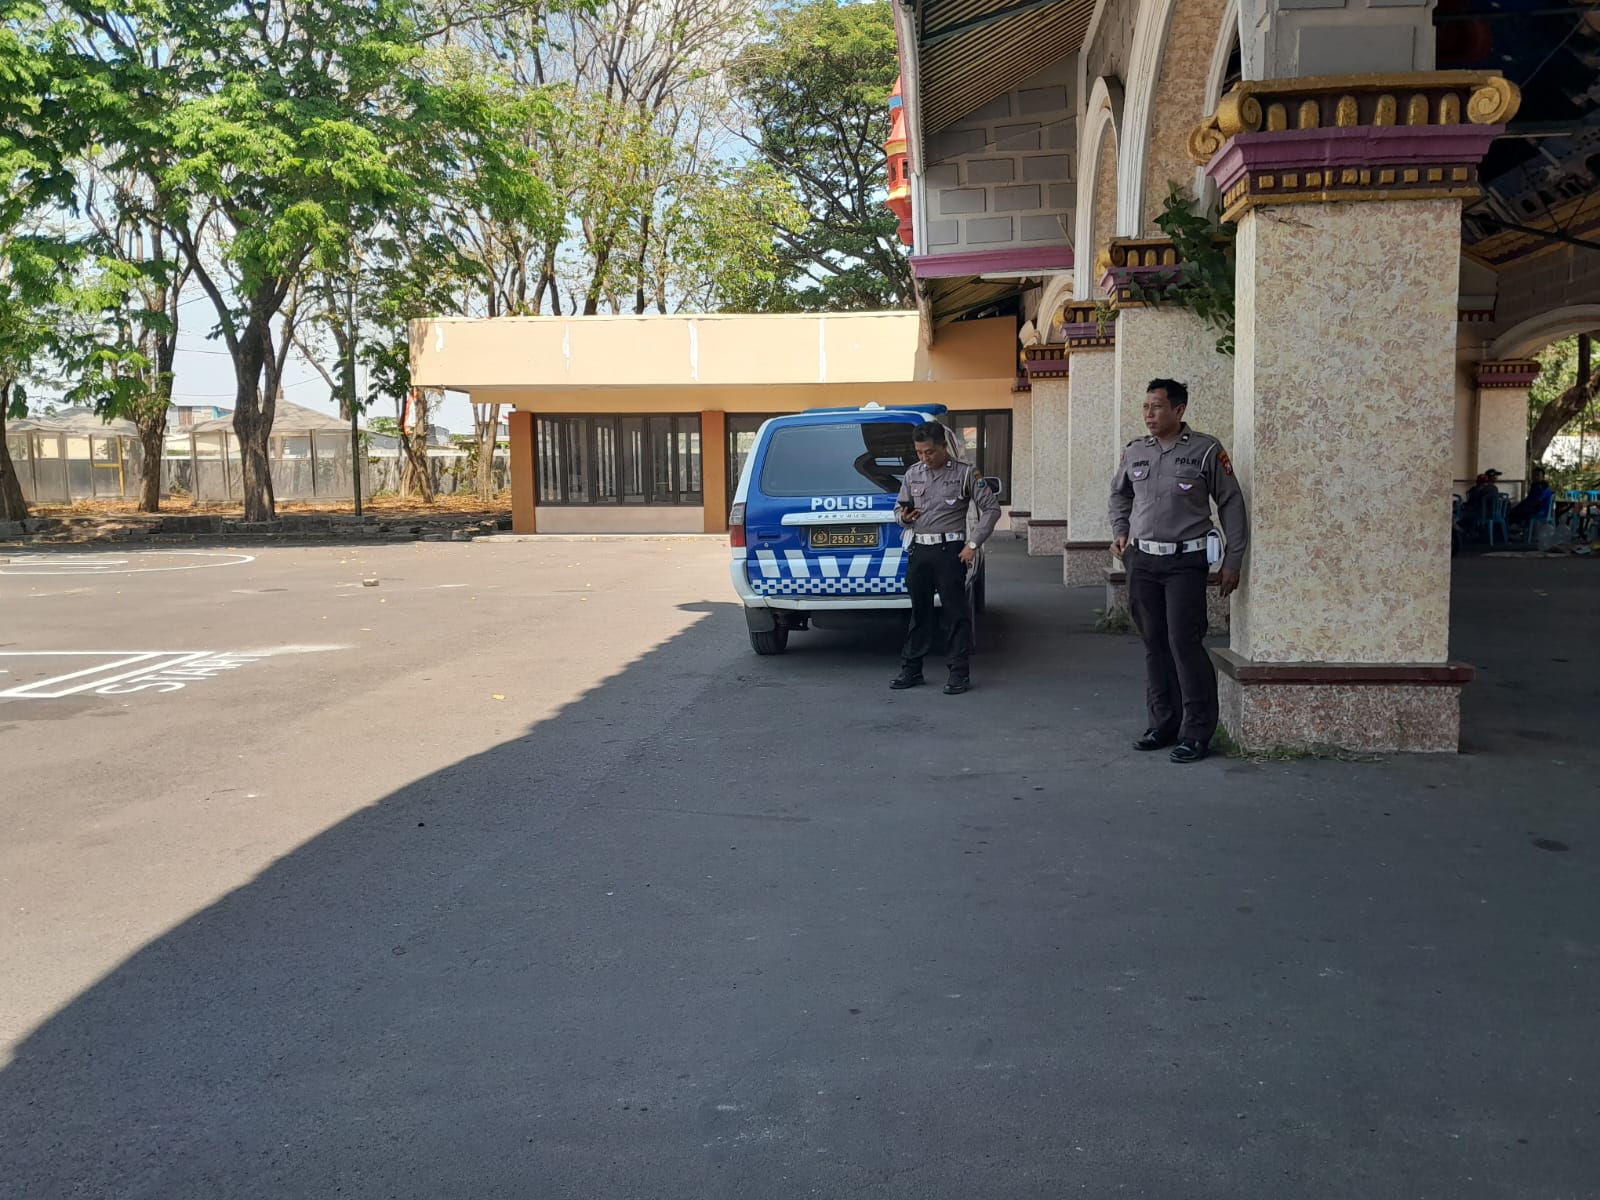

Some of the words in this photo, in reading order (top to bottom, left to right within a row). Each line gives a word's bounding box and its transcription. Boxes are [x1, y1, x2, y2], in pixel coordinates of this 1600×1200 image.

[811, 496, 873, 510] POLISI
[832, 535, 855, 544] 2503
[863, 535, 874, 543] 32
[95, 652, 271, 694] START
